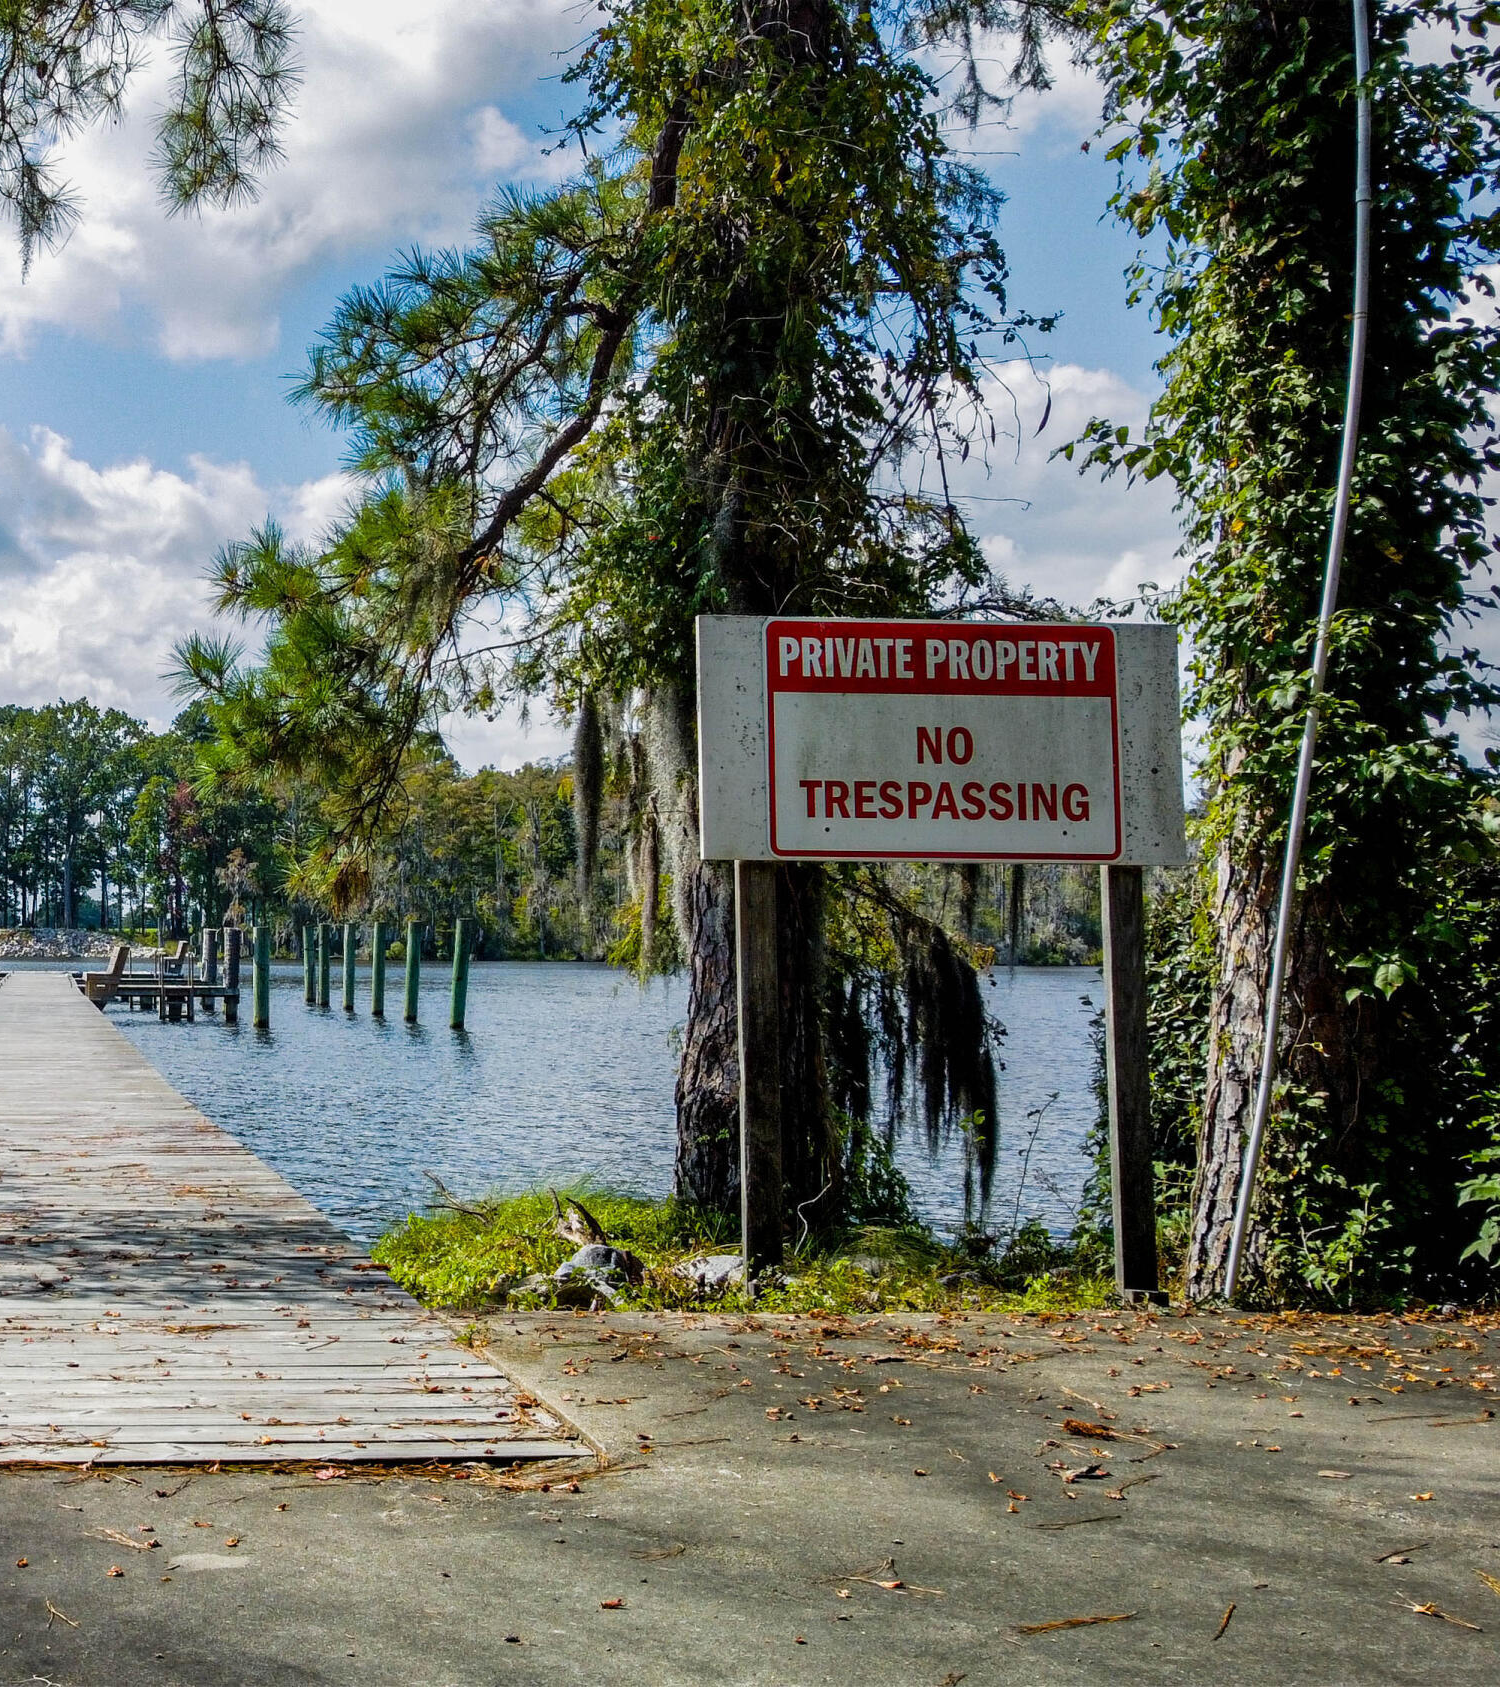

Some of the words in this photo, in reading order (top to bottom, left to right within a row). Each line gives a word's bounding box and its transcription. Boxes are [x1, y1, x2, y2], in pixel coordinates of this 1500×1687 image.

[778, 636, 914, 679] PRIVATE
[925, 638, 1101, 682] PROPERTY
[916, 726, 974, 765] NO
[800, 779, 1090, 822] TRESPASSING
